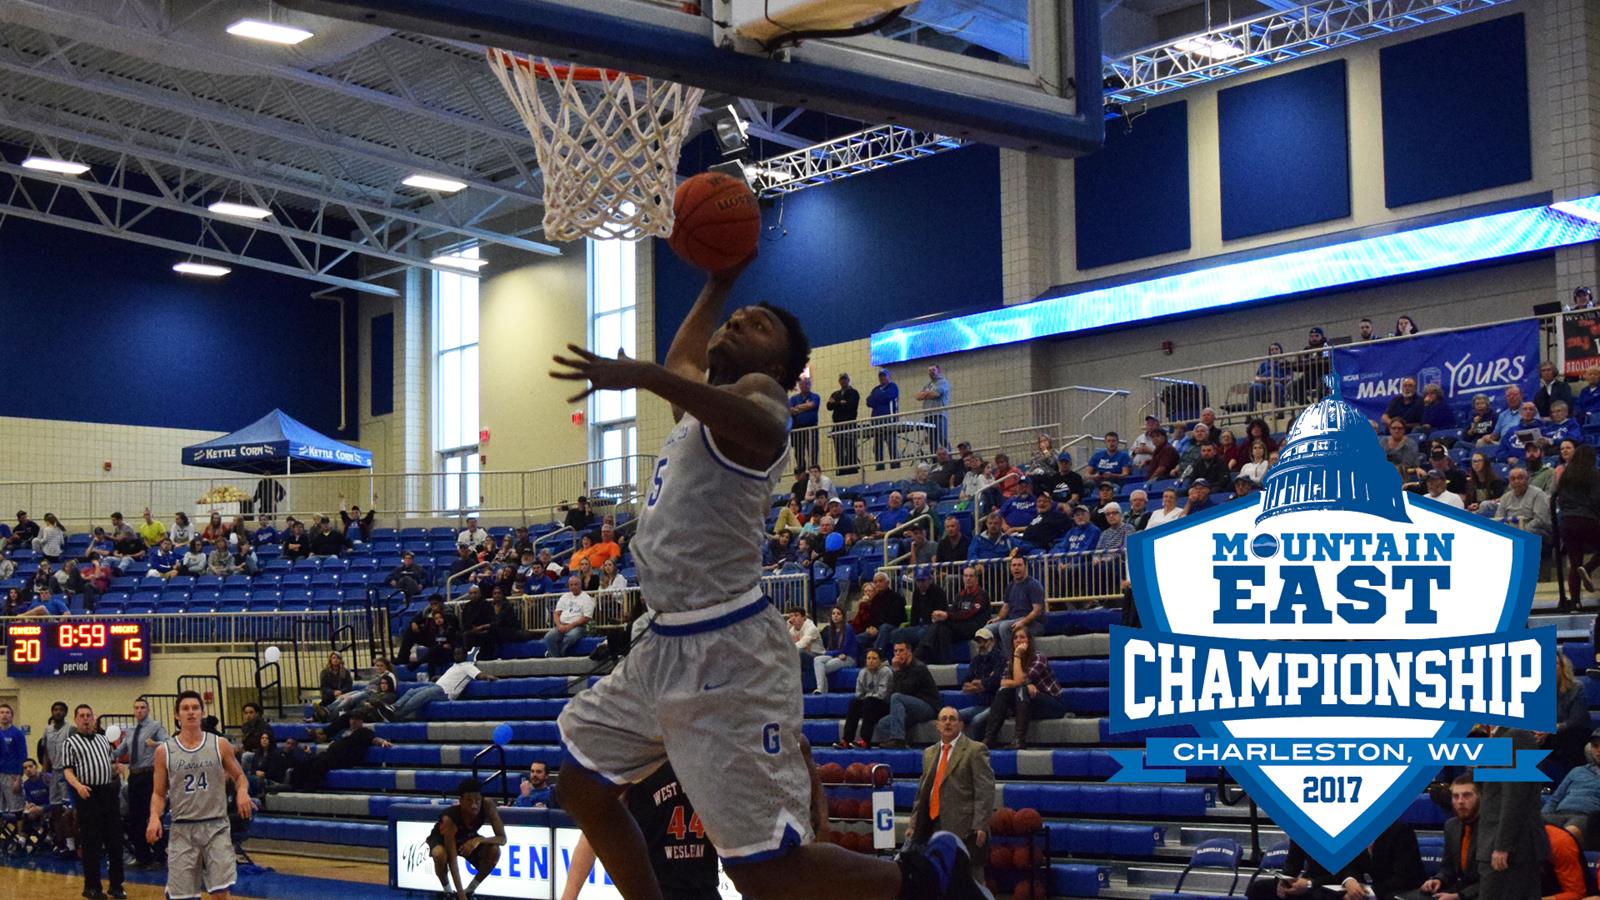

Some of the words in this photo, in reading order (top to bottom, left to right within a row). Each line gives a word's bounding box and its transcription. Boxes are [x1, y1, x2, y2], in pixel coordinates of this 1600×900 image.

[1444, 353, 1527, 398] YOURS
[206, 448, 237, 459] KETTLE
[240, 445, 264, 457] CORN
[308, 445, 333, 459] KETTLE
[336, 451, 355, 462] CORN
[646, 457, 669, 508] 5
[59, 624, 105, 648] 8:59
[14, 639, 41, 662] 20
[124, 638, 143, 661] 15
[63, 661, 89, 673] period
[101, 657, 108, 674] 1
[762, 721, 782, 756] G
[184, 772, 209, 794] 24
[653, 781, 678, 806] WEST
[667, 805, 705, 840] 44
[876, 808, 894, 831] G
